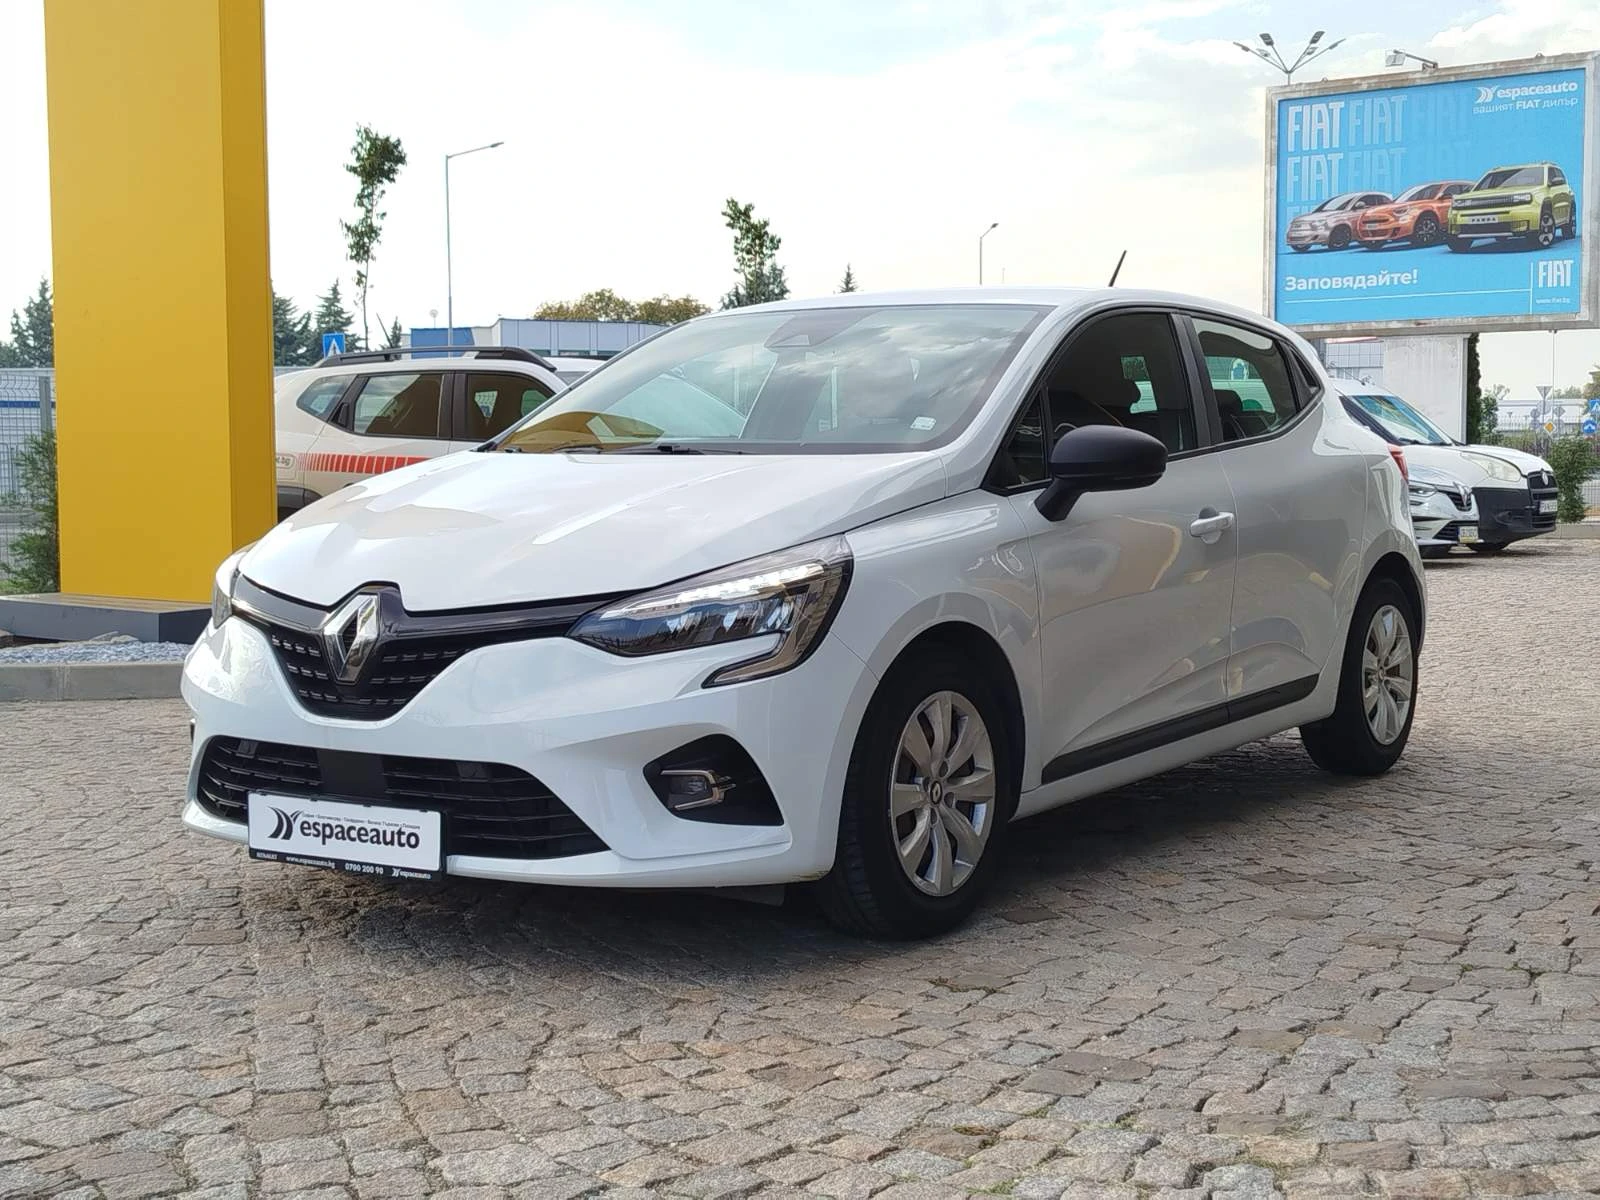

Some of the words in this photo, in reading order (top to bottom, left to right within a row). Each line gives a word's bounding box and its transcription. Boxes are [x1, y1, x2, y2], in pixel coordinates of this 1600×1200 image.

[1496, 81, 1578, 100] espaceauto
[1473, 104, 1514, 114] вашият
[1515, 99, 1541, 110] FIAT
[1287, 101, 1345, 152] FIAT
[1348, 94, 1408, 146] FIAT
[1286, 152, 1344, 202] FIAT
[1284, 268, 1418, 291] Заповядайте!
[1538, 259, 1574, 288] FIAT
[300, 820, 420, 849] espaceauto
[345, 862, 360, 871] 0700
[362, 865, 374, 873] 200
